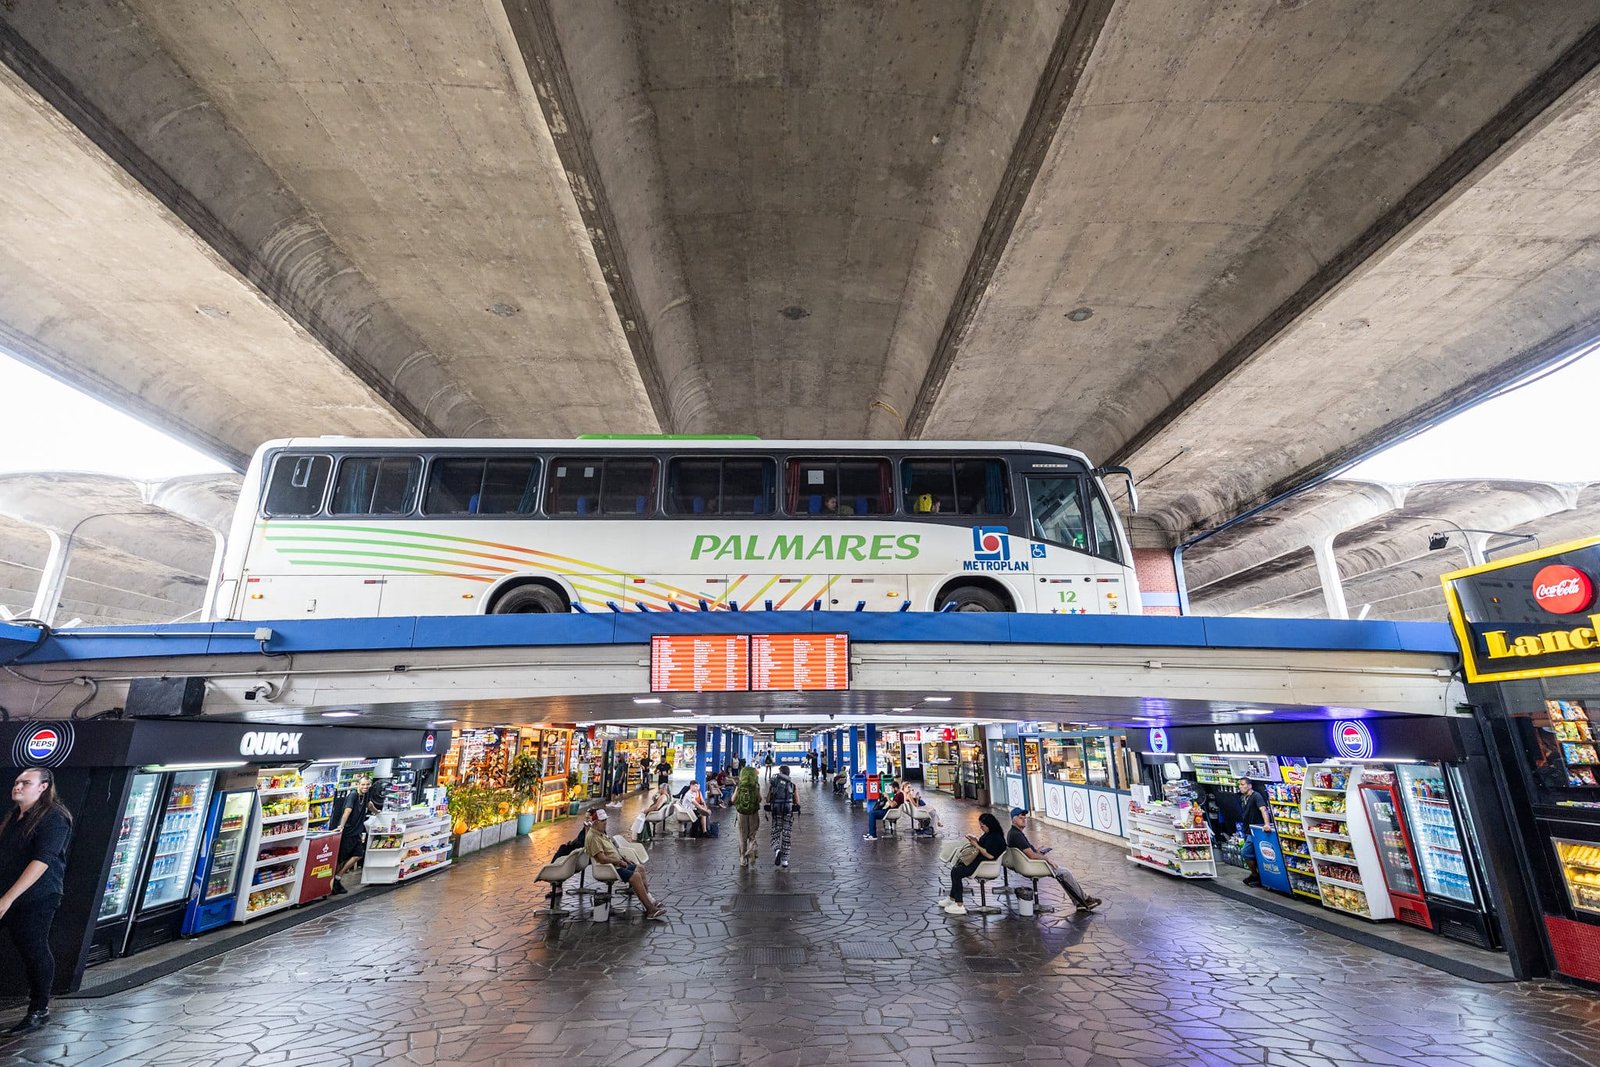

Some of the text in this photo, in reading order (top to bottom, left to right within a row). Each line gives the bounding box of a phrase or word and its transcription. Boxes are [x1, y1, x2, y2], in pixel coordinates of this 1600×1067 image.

[690, 534, 921, 561] PALMARES
[963, 561, 1029, 571] METROPLAN
[1058, 591, 1077, 603] 12
[1536, 577, 1580, 599] Coca-Cola
[240, 731, 303, 755] QUICK
[1221, 732, 1245, 752] PRA
[1244, 728, 1260, 752] JÁ
